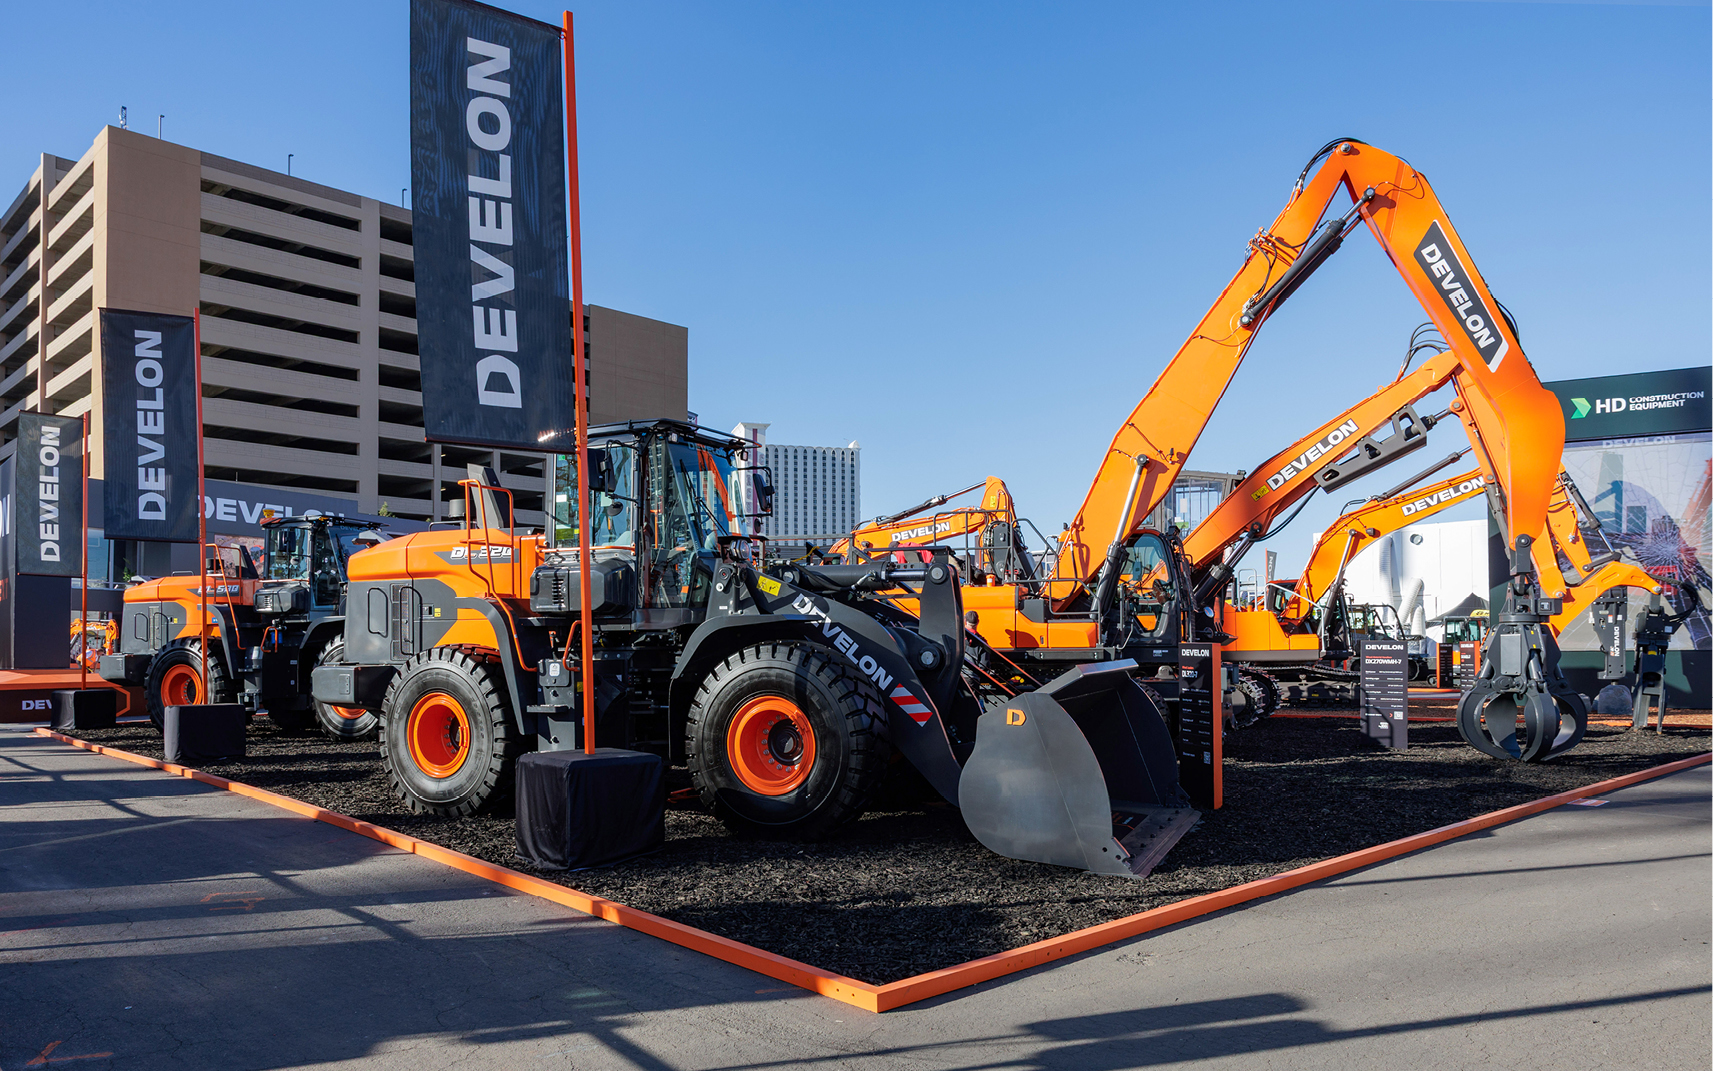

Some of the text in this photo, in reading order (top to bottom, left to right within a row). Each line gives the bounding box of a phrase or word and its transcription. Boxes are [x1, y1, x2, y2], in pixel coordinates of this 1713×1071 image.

[467, 36, 522, 409] DEVELON
[1421, 243, 1495, 349] DEVELON
[1595, 397, 1627, 414] HD
[1629, 391, 1705, 404] CONSTRUCTION
[1629, 399, 1686, 411] EQUIPMENT
[134, 329, 166, 521] DEVELON
[1602, 436, 1676, 449] DEVELON
[1267, 419, 1359, 491] DEVELON
[39, 425, 61, 562] DEVELON
[1401, 476, 1485, 517] DEVELON
[891, 522, 950, 541] DEVELON
[1181, 649, 1210, 657] DEVELON
[1006, 708, 1026, 726] D
